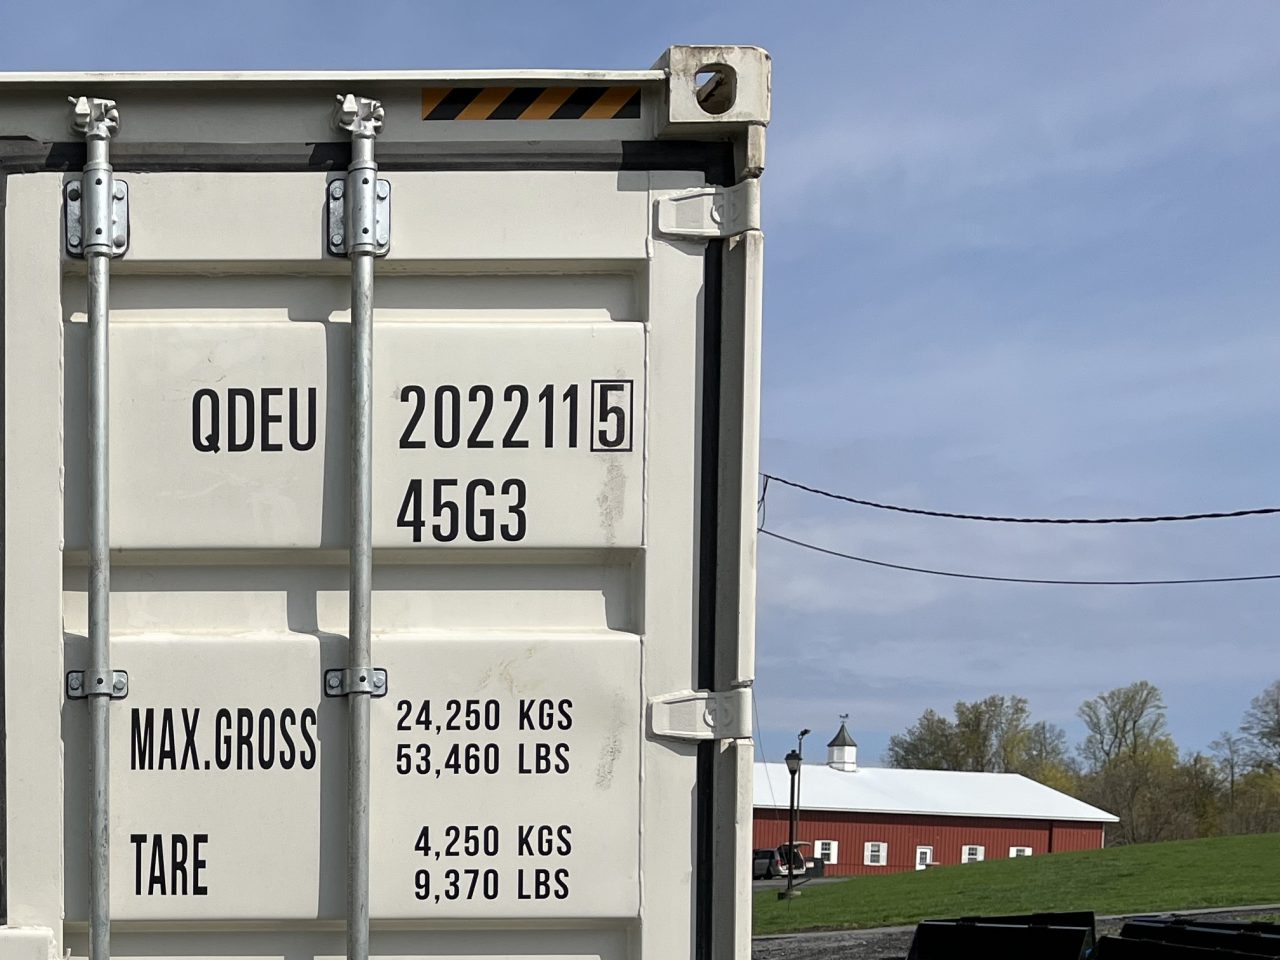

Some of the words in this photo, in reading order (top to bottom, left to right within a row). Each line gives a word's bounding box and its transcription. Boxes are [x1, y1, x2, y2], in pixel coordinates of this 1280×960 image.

[192, 387, 317, 454] QDEU
[396, 478, 527, 543] 45G3
[130, 705, 318, 771] MAX.GROSS
[397, 699, 500, 734] 24,250
[519, 698, 573, 731] KGS
[396, 742, 500, 778] 53,460
[518, 742, 570, 774] LBS
[130, 833, 209, 896] TARE
[414, 825, 499, 860] 4,250
[518, 824, 572, 856] KGS
[414, 868, 499, 904] 9,370
[517, 868, 569, 900] LBS
